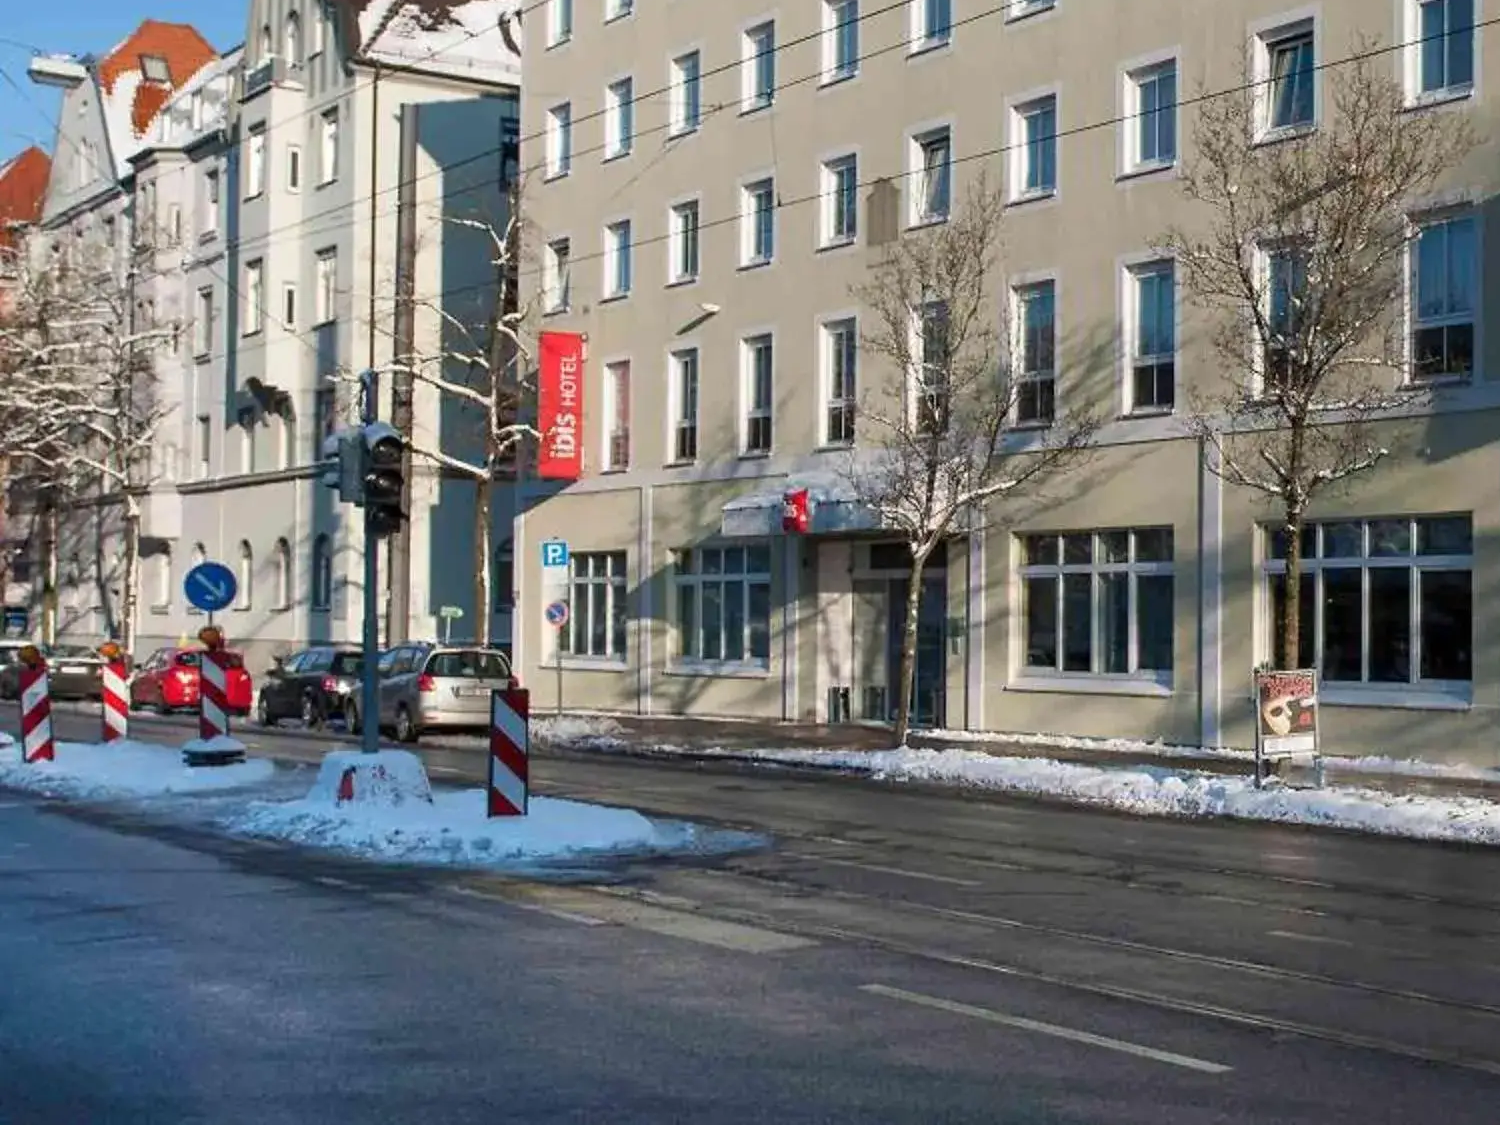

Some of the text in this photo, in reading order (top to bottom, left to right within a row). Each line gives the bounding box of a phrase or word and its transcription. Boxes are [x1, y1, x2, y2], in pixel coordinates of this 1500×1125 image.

[550, 353, 577, 459] ibis HOTEL
[547, 544, 563, 564] P
